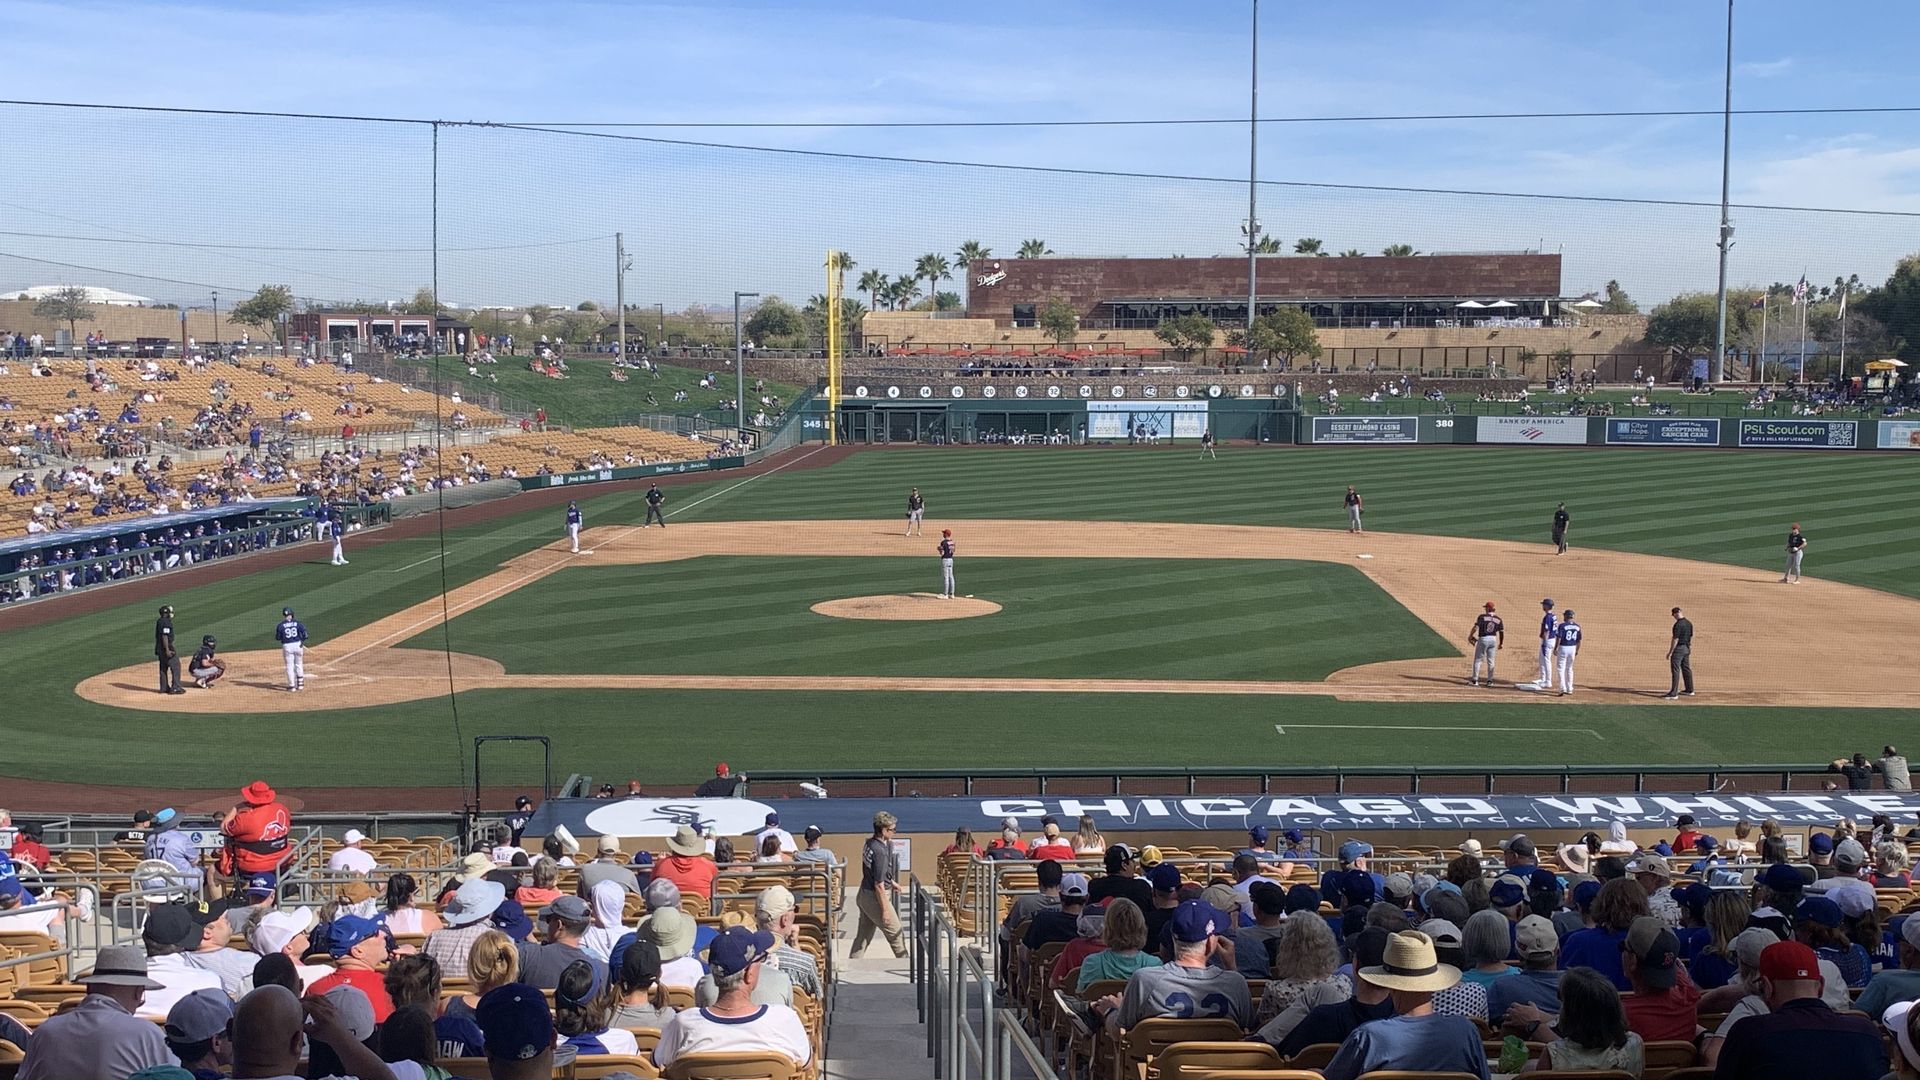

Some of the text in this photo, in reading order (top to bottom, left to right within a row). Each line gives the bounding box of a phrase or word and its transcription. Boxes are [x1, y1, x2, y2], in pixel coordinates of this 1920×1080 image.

[977, 270, 1007, 287] Dodgers
[803, 420, 821, 429] 345
[1435, 420, 1454, 428] 380
[1744, 424, 1824, 435] PSL Scout.com
[284, 627, 298, 639] 98
[1565, 630, 1578, 641] 84
[980, 795, 1920, 817] CHICAGO WHITE
[1293, 816, 1537, 824] CAMELBACK
